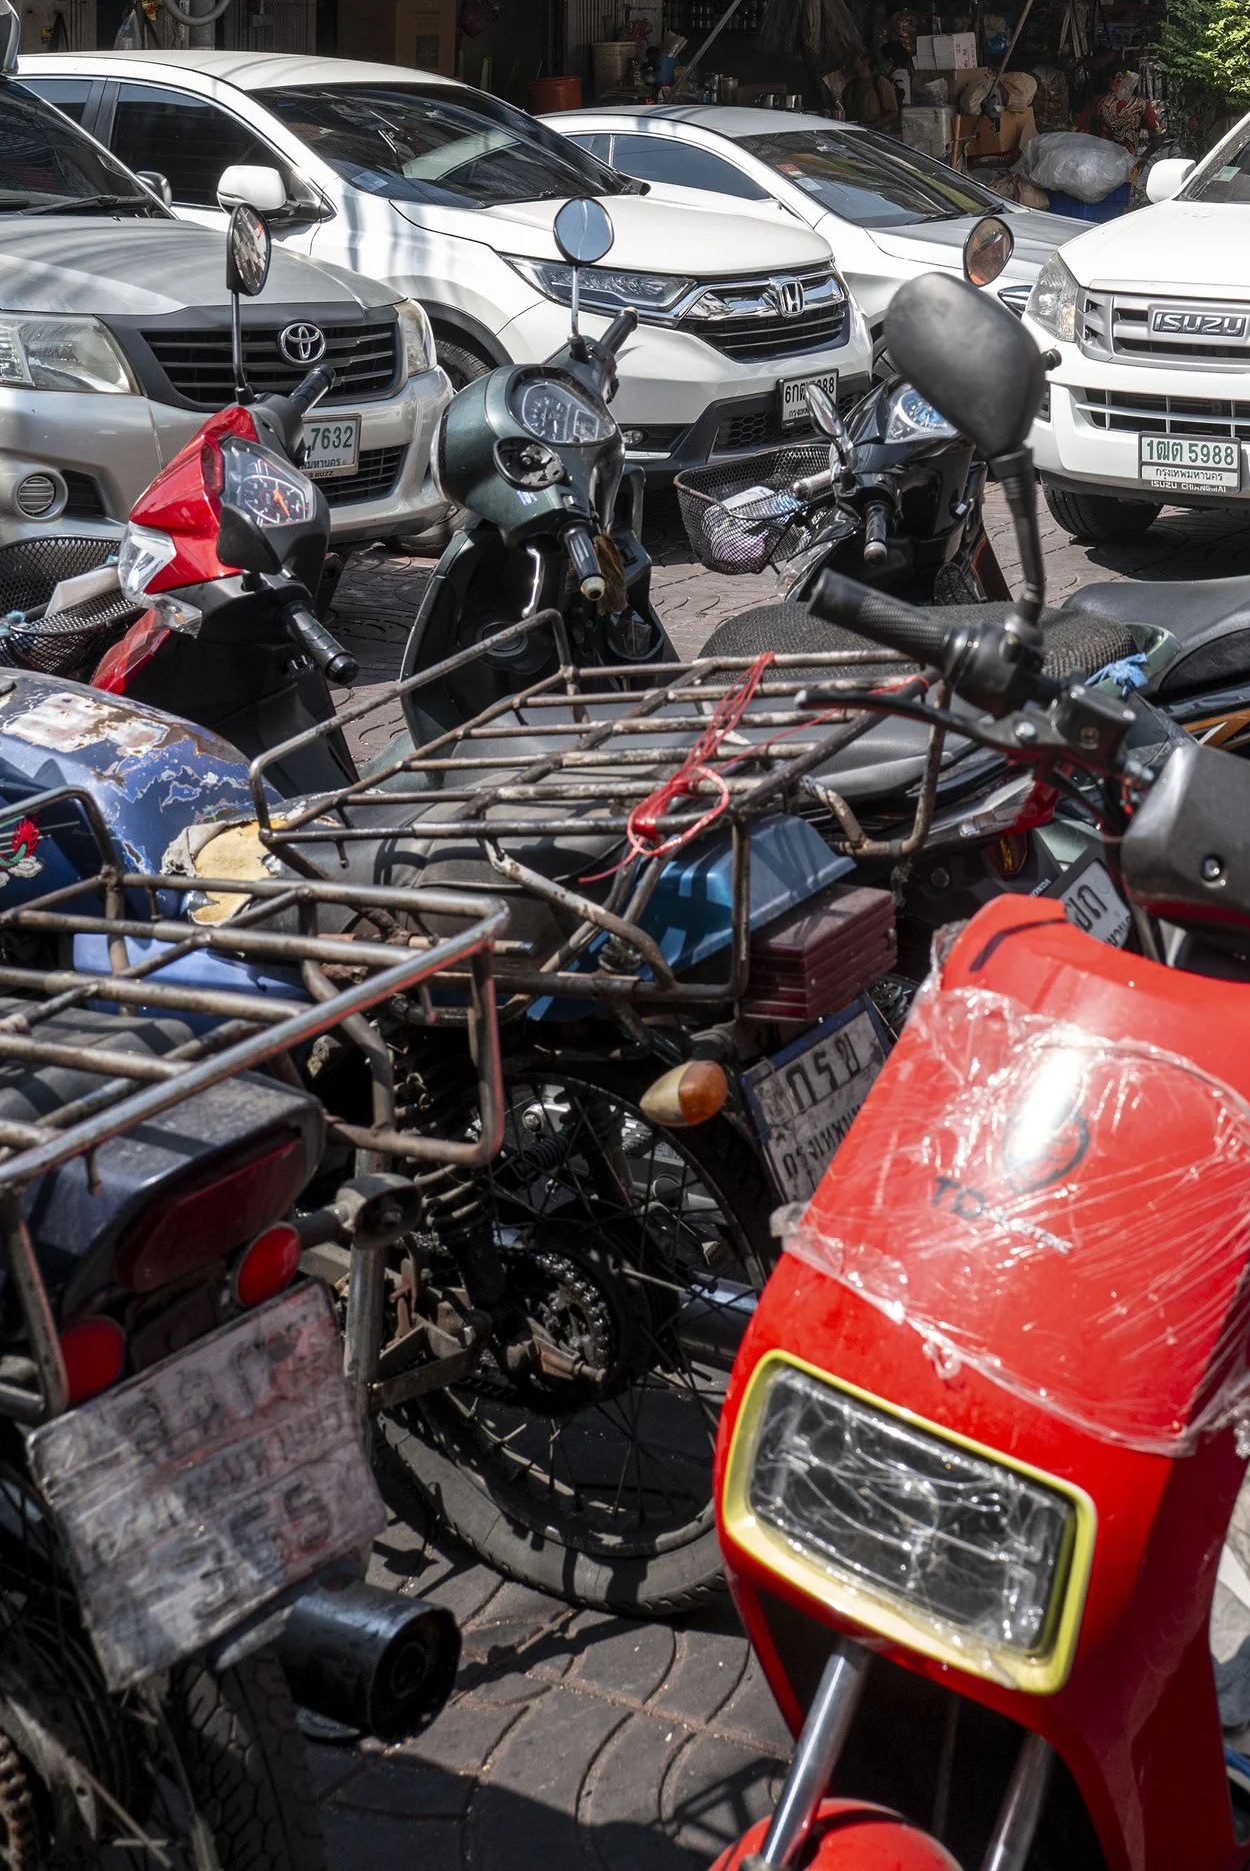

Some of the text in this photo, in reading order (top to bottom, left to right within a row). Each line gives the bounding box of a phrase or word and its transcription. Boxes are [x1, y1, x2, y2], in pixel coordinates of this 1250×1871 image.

[1154, 312, 1244, 335] ISUZU
[310, 425, 354, 451] 7632
[1188, 443, 1234, 466] 5988
[1151, 479, 1178, 490] ISUZU
[1155, 466, 1224, 483] กรุงเทพมหานคร
